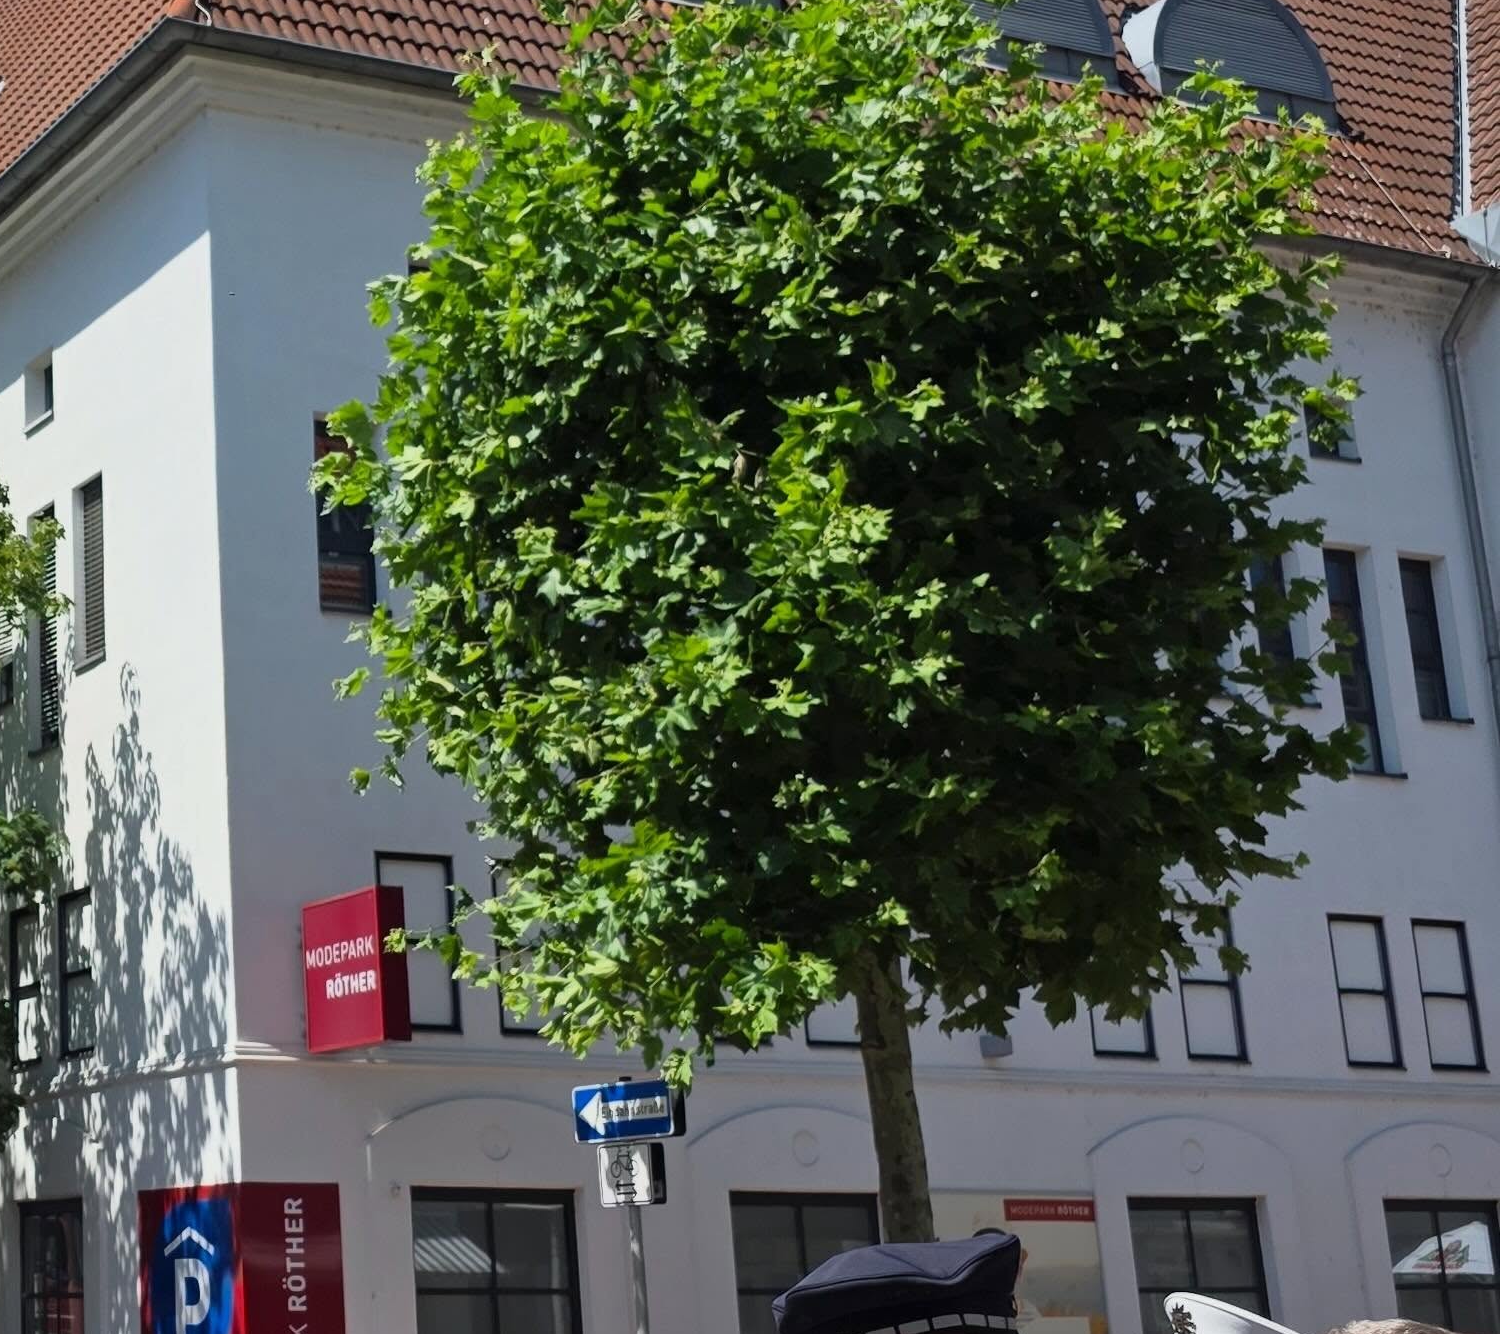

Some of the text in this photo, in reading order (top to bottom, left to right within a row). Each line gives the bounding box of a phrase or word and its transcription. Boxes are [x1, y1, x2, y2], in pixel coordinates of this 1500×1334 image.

[306, 935, 374, 969] MODEPARK
[326, 969, 377, 999] RÖTHER
[282, 1197, 309, 1312] RÖTHER
